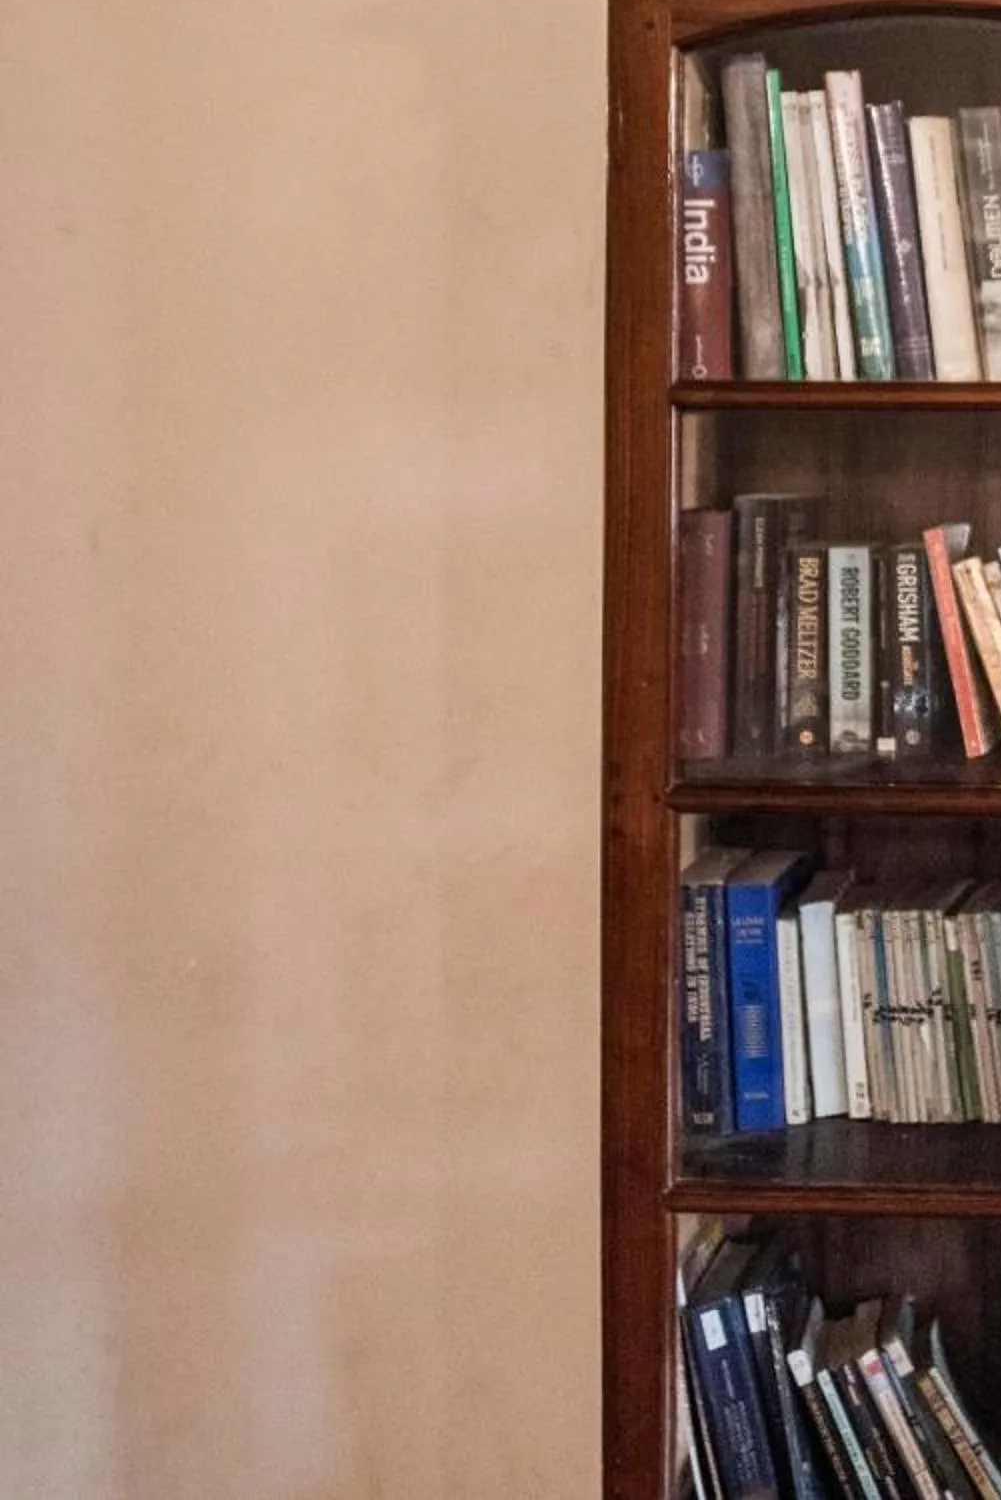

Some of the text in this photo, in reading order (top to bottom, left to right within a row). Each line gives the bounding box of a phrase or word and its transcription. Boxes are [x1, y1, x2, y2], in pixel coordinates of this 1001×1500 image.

[684, 199, 715, 285] India
[798, 557, 820, 680] BRAD MELTZER
[840, 566, 862, 701] ROBERT GODDARD
[896, 563, 921, 642] GRISHAM
